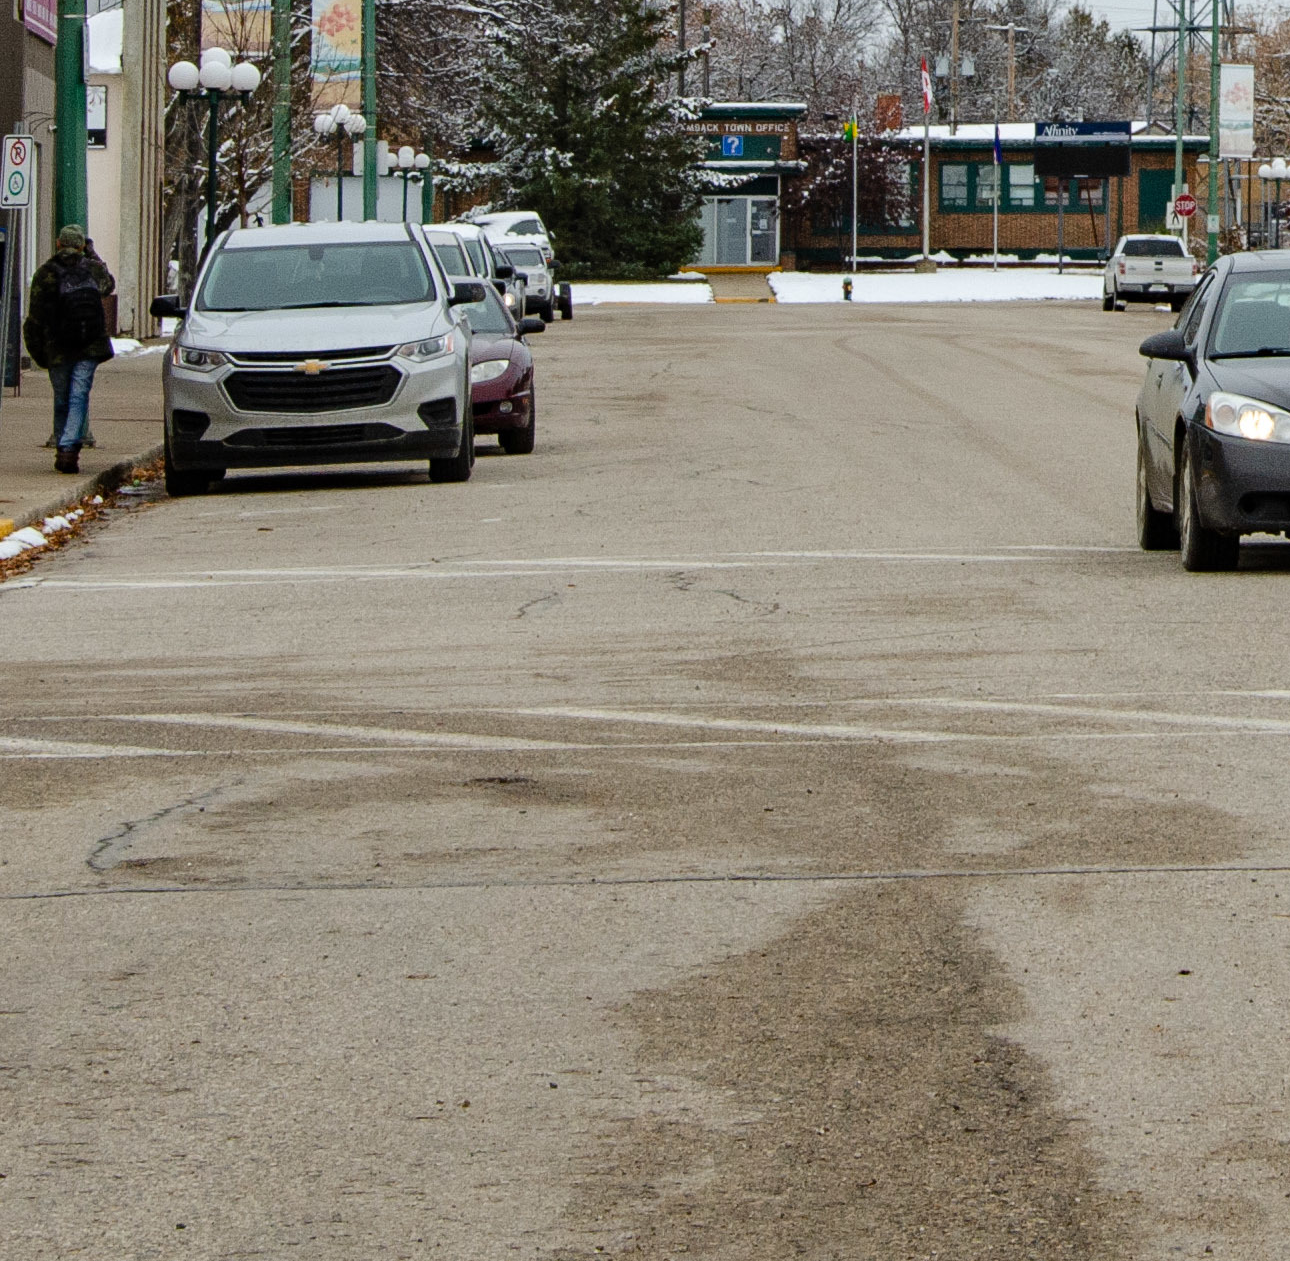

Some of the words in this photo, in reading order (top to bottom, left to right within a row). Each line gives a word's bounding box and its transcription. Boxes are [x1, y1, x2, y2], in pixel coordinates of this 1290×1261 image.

[724, 124, 752, 132] TOWN
[756, 124, 790, 132] OFFICE
[1042, 124, 1079, 136] Affinity
[1176, 201, 1195, 210] STOP
